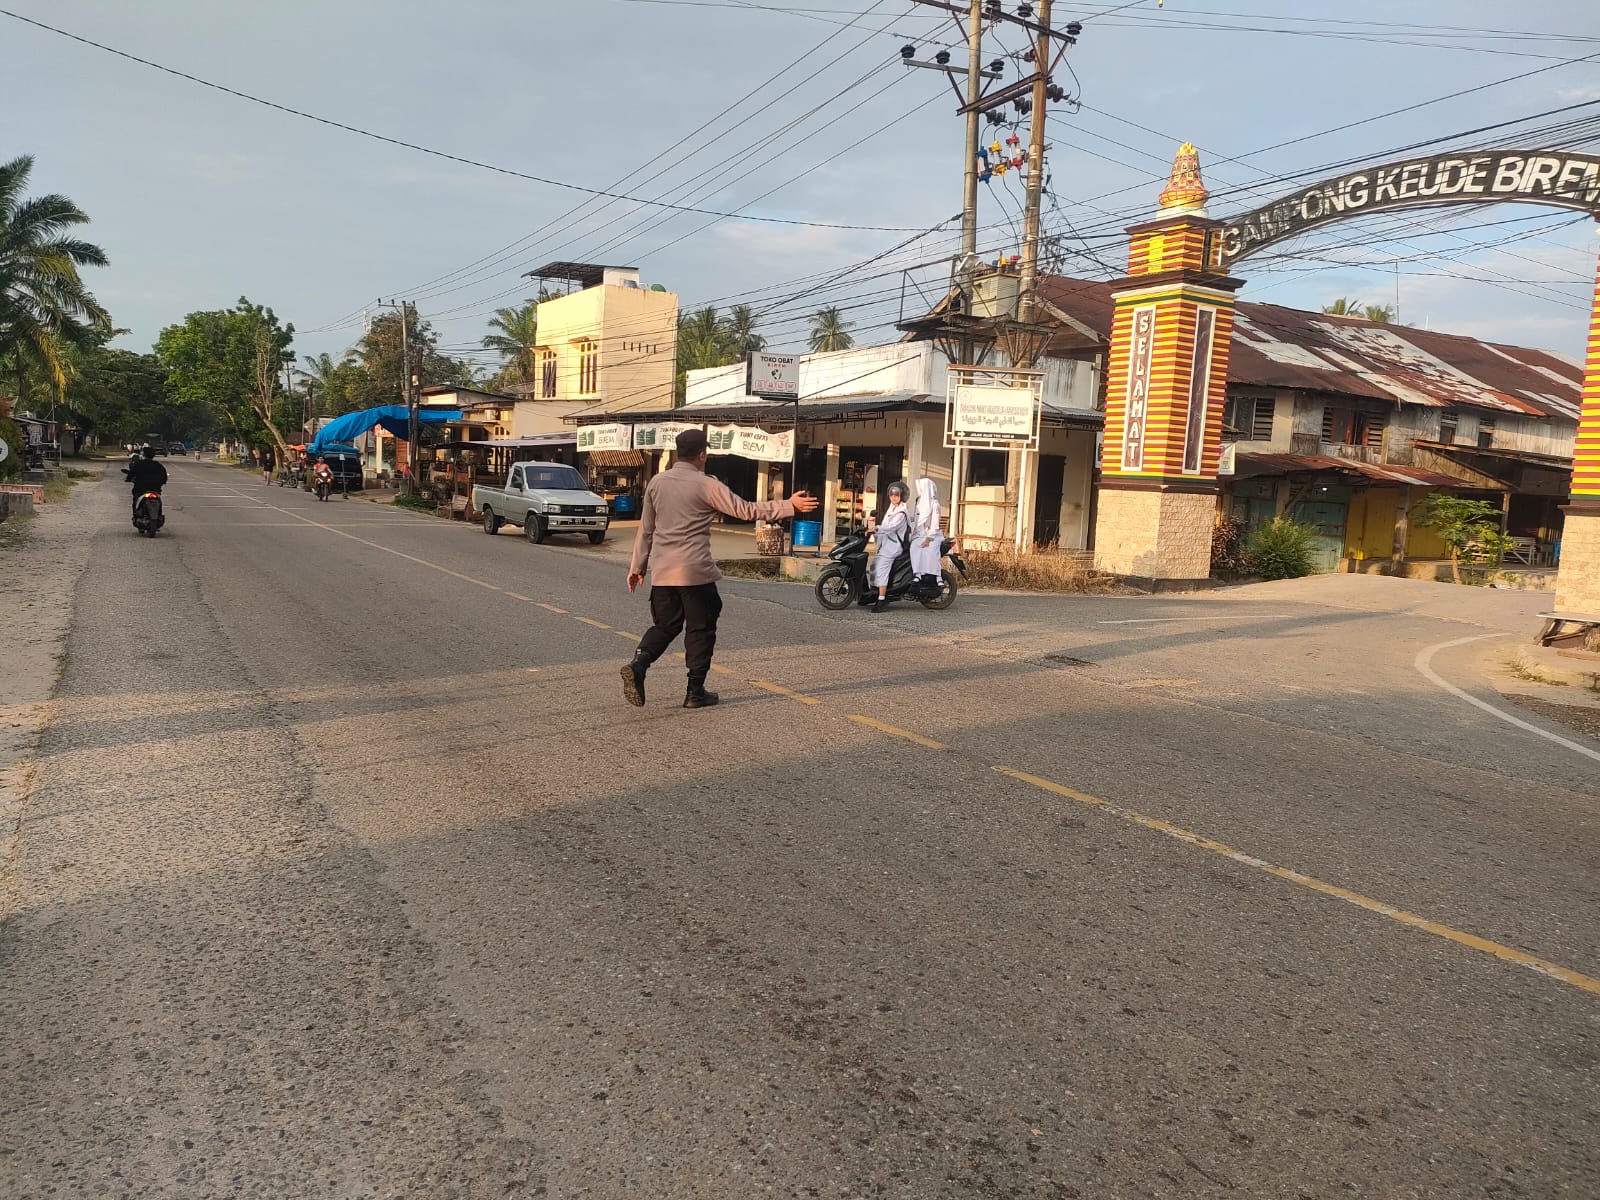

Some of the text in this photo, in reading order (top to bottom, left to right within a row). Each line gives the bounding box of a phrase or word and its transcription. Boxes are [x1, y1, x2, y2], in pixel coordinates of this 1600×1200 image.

[1222, 174, 1369, 257] GAMPONG
[1375, 157, 1492, 202] KEUDE
[760, 355, 794, 365] TOKO OBAT
[1127, 316, 1150, 462] SELAMAT
